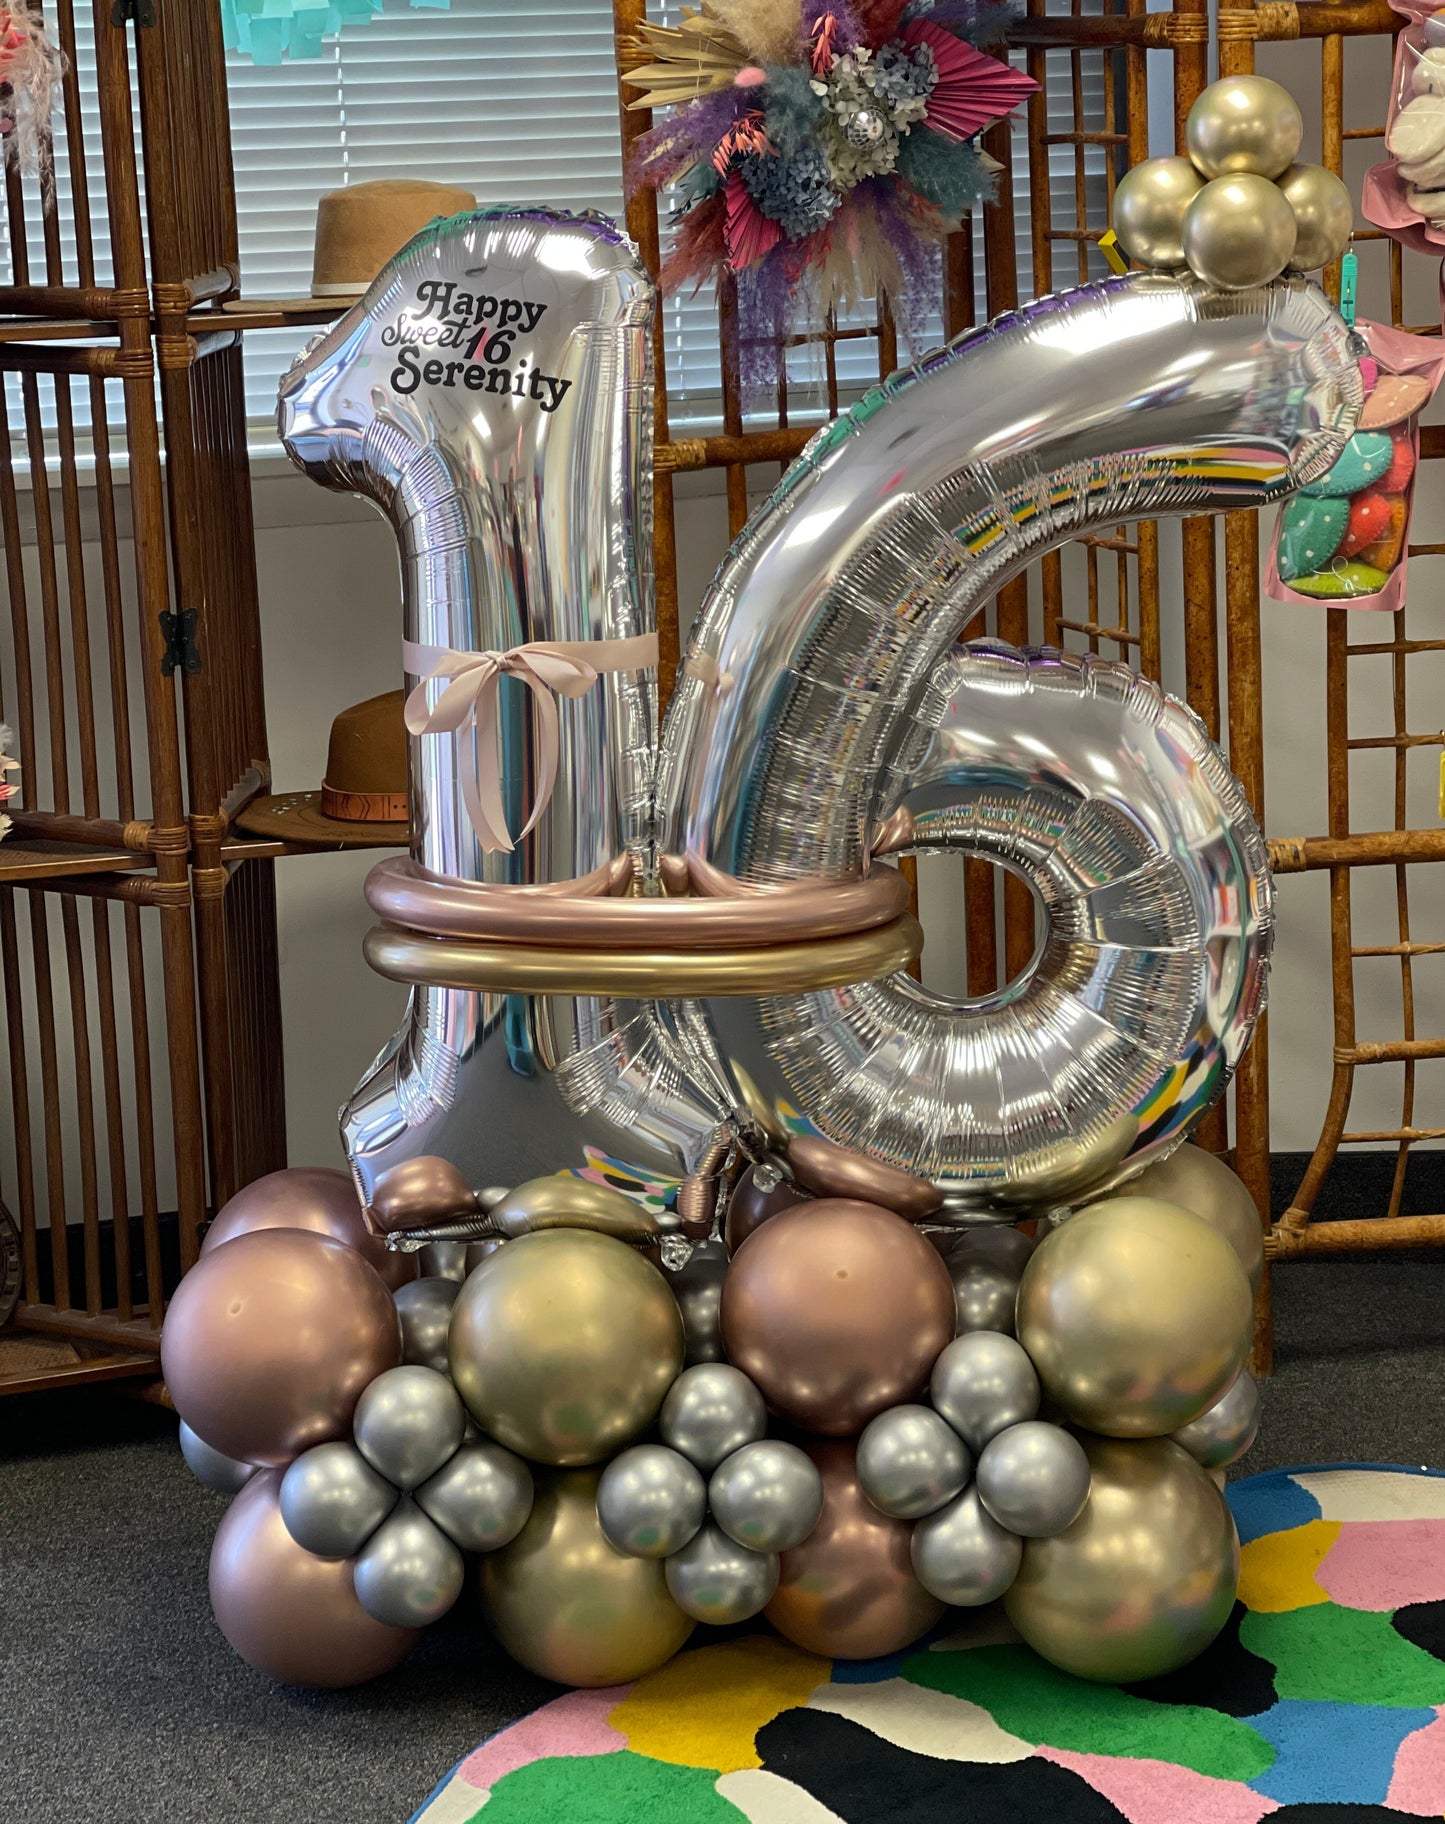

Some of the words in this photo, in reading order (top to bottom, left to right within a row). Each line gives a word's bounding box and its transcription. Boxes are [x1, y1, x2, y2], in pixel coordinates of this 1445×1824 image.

[411, 280, 548, 333] Happy
[381, 314, 472, 349] Sweet
[463, 327, 517, 364] 16
[390, 346, 572, 413] Serenity
